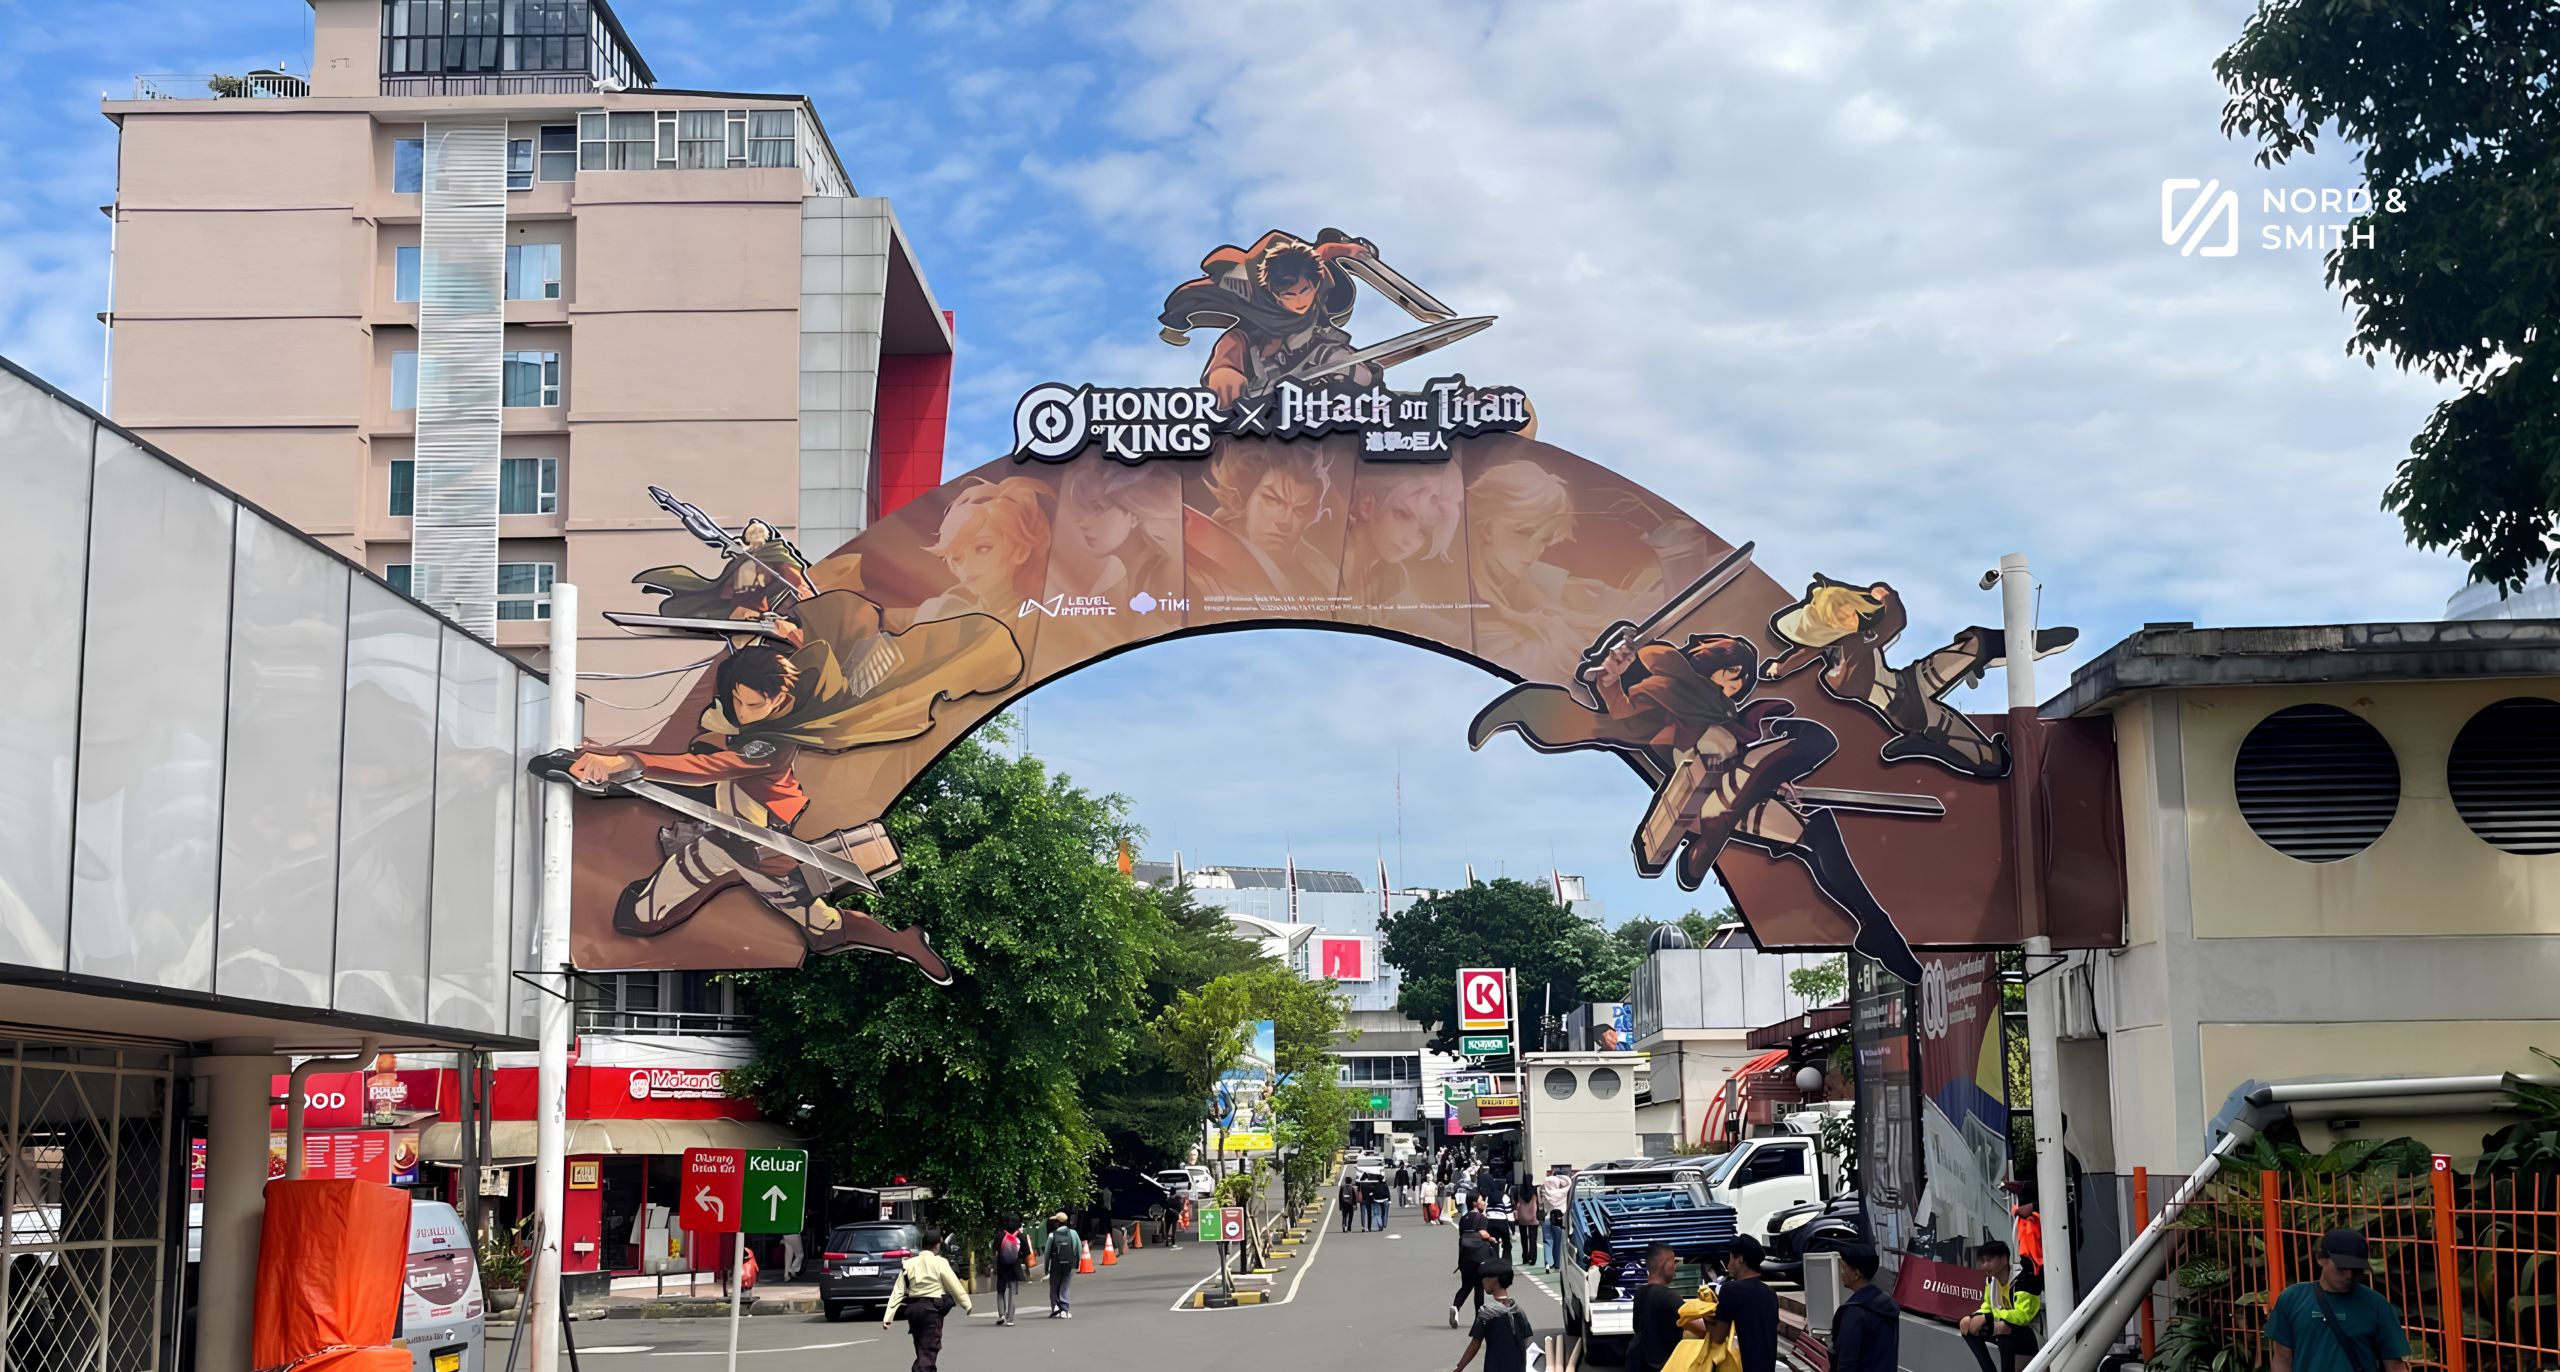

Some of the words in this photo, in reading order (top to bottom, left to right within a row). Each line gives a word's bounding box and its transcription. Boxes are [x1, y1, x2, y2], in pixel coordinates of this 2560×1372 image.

[1090, 392, 1228, 423] HONOR
[1276, 381, 1395, 430] Attack
[1398, 399, 1428, 420] on
[1431, 381, 1531, 430] Titan
[1091, 425, 1105, 435] OF
[1105, 424, 1211, 459] KINGS
[1068, 596, 1110, 606] LEVEL
[750, 1156, 803, 1172] Keluar
